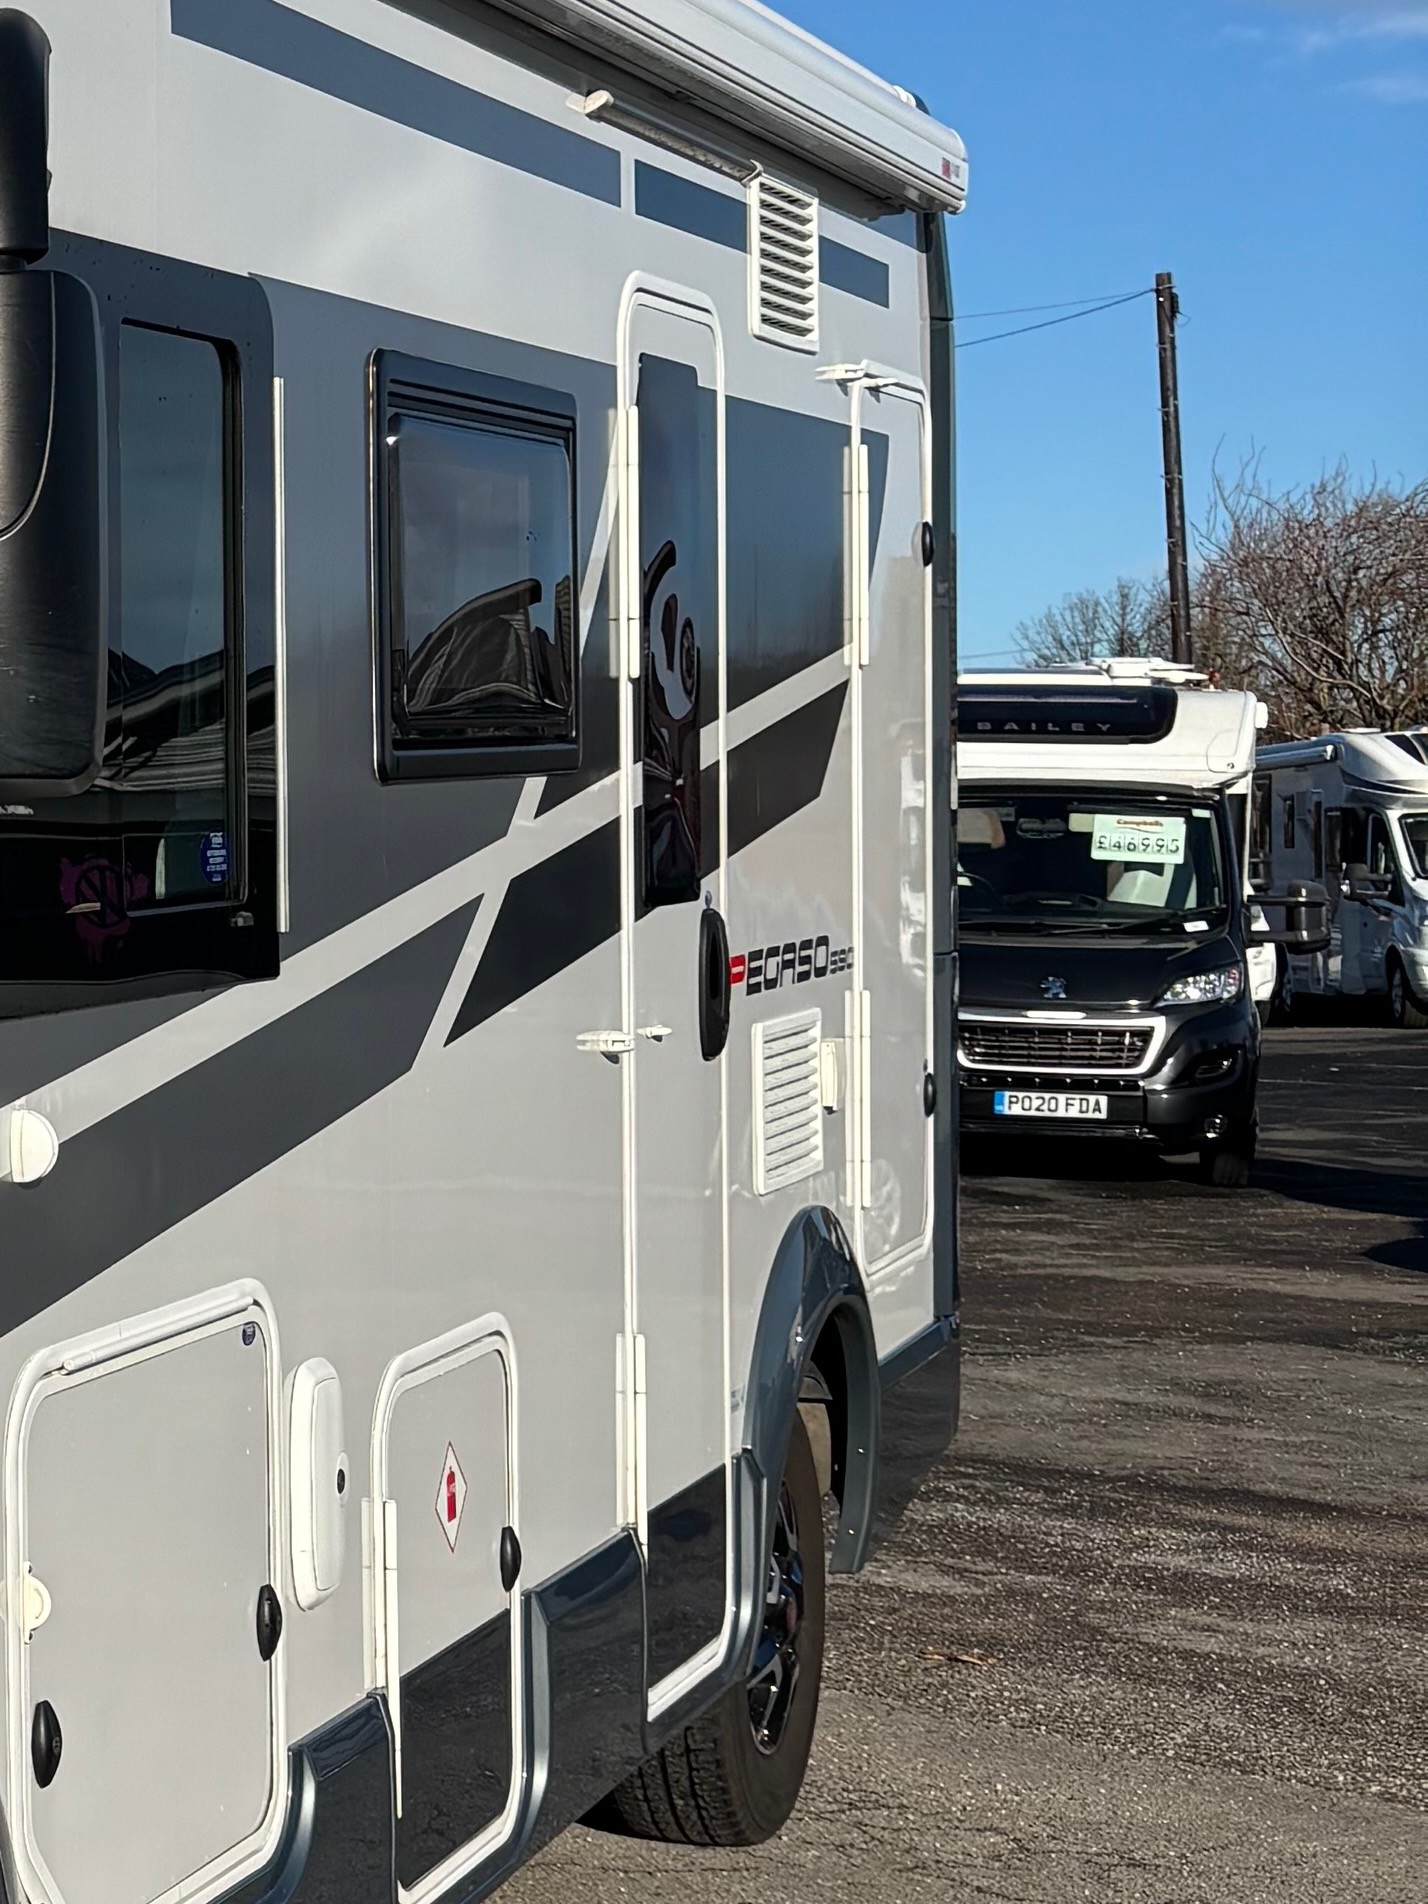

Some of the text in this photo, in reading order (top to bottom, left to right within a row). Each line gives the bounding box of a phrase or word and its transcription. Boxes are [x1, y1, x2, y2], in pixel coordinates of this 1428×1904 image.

[976, 721, 1111, 732] BAILEY
[1097, 834, 1180, 854] £46995
[1008, 1095, 1102, 1114] PO20 FDA
